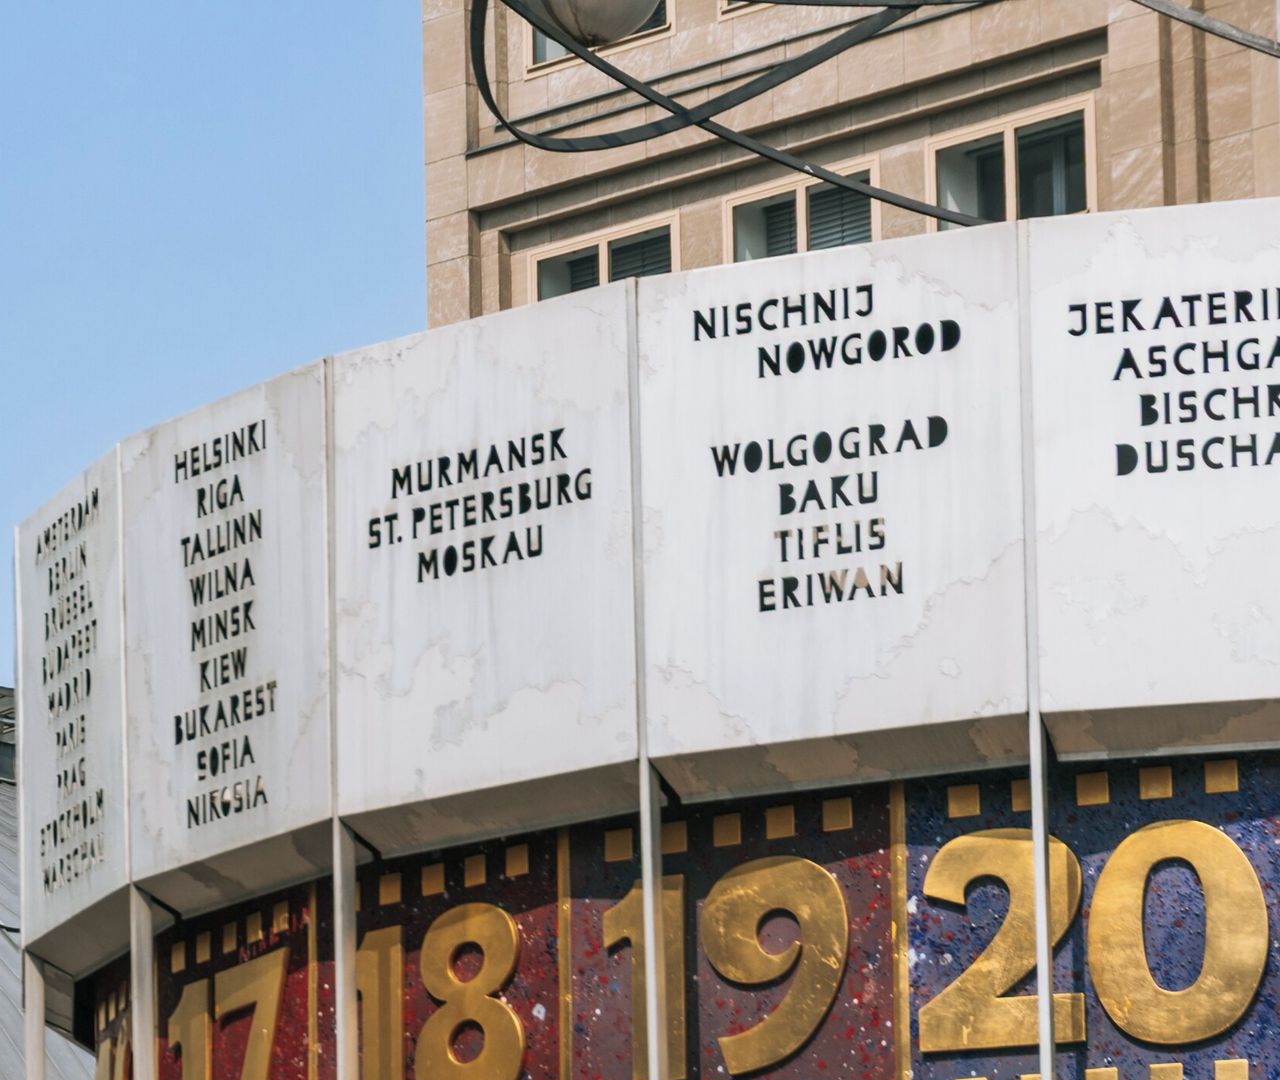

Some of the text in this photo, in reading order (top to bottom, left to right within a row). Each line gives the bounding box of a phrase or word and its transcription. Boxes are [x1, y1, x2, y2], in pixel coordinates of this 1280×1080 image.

[692, 283, 874, 341] NISCHNIJ
[1067, 287, 1280, 337] JEKATERI
[757, 319, 961, 378] NOWGOROD
[174, 420, 268, 483] HELSINKI
[391, 428, 568, 499] MURMANSK
[711, 415, 949, 478] WOLGOGRAD
[197, 474, 243, 518] RIGA
[368, 468, 593, 549] ST. PETERSBURG
[778, 471, 878, 516] BAKU
[35, 488, 100, 566] AMSTERDAM
[180, 509, 263, 567] TALLINN
[417, 525, 543, 583] MOSKAU
[774, 518, 886, 563] TIFLIS
[48, 540, 87, 597] BERLIN
[190, 558, 255, 607] WILNA
[757, 561, 904, 613] ERIWAN
[42, 618, 97, 686] BUDAPEST
[191, 600, 256, 651] MINSK
[48, 668, 92, 724] MADRID
[200, 648, 248, 691] KIEW
[56, 714, 85, 760] PARIS
[173, 681, 278, 746] BUKAREST
[57, 756, 85, 803] PRAG
[197, 735, 256, 781] SOFIA
[186, 776, 269, 829] NIKOSIA
[918, 818, 1268, 1053] 20
